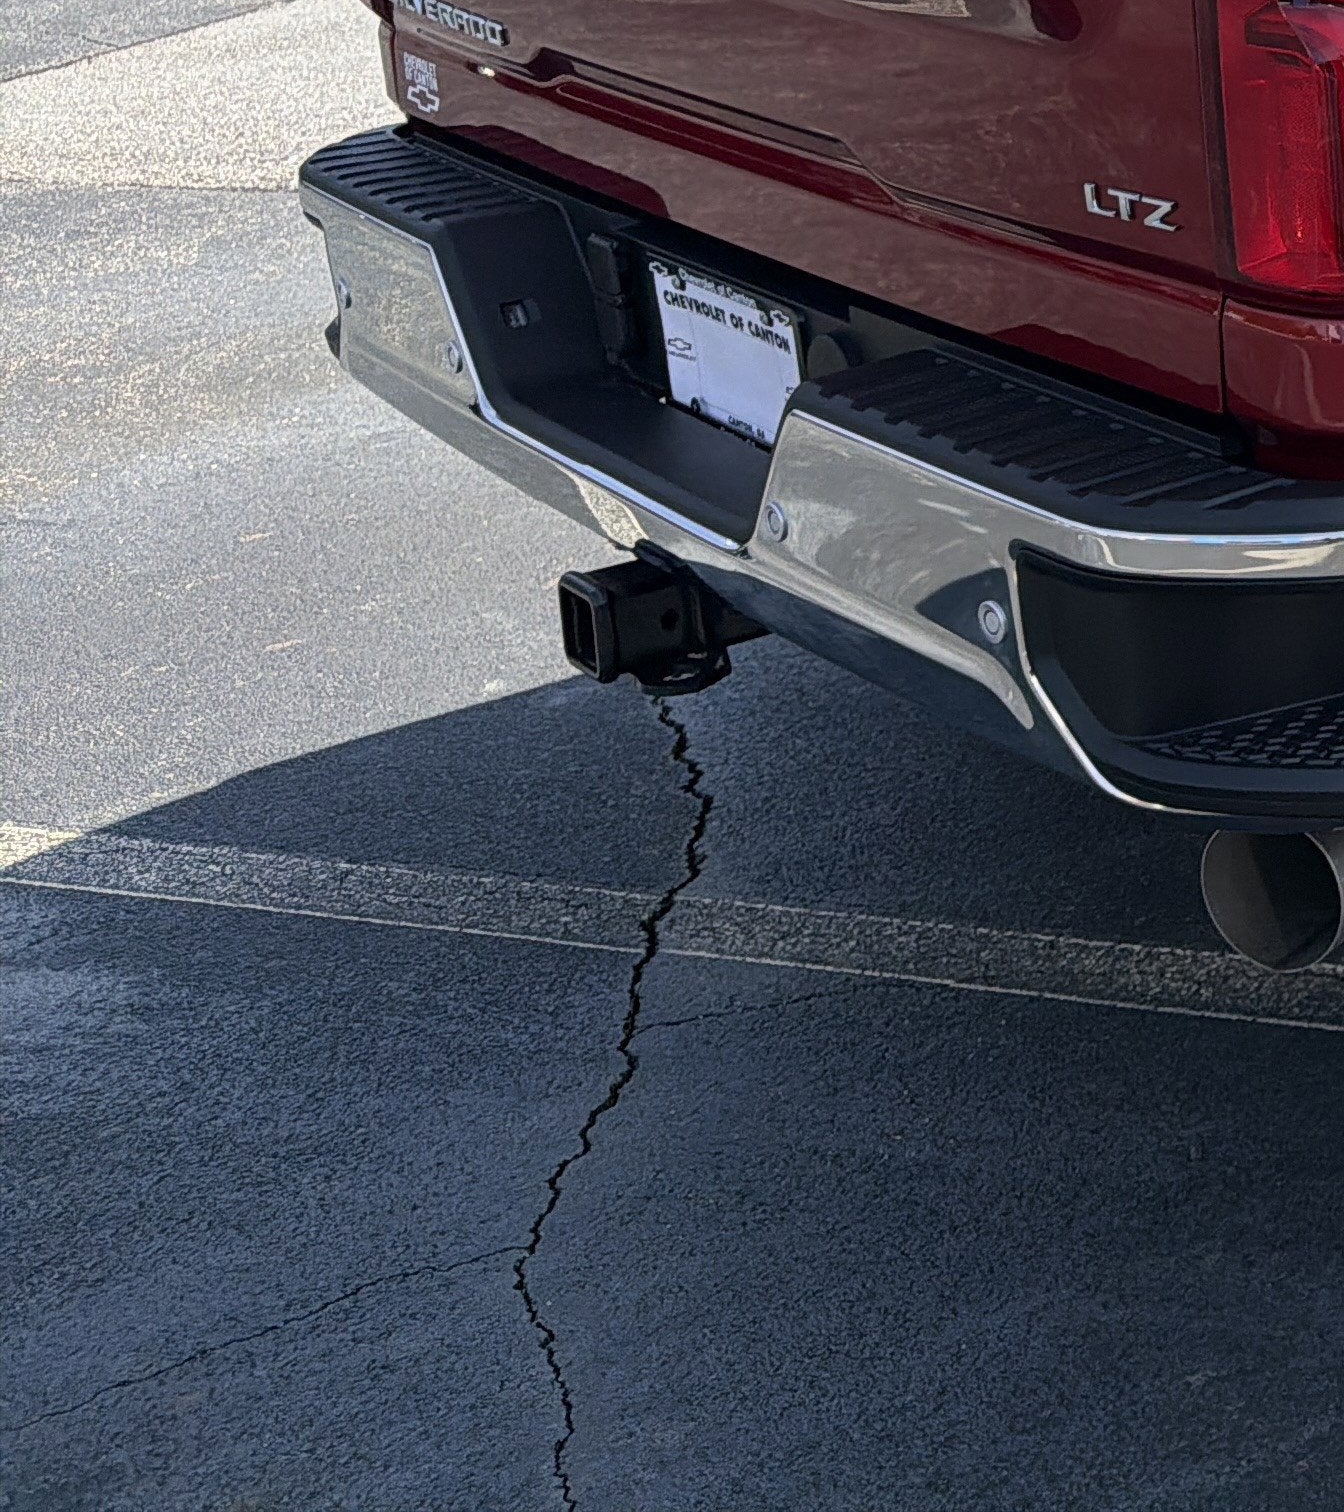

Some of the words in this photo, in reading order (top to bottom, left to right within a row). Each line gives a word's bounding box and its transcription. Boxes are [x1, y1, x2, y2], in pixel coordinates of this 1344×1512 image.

[1084, 182, 1180, 232] LTZ
[663, 290, 726, 325] CHEVROLET
[730, 313, 744, 332] OF
[748, 320, 791, 355] CANTON
